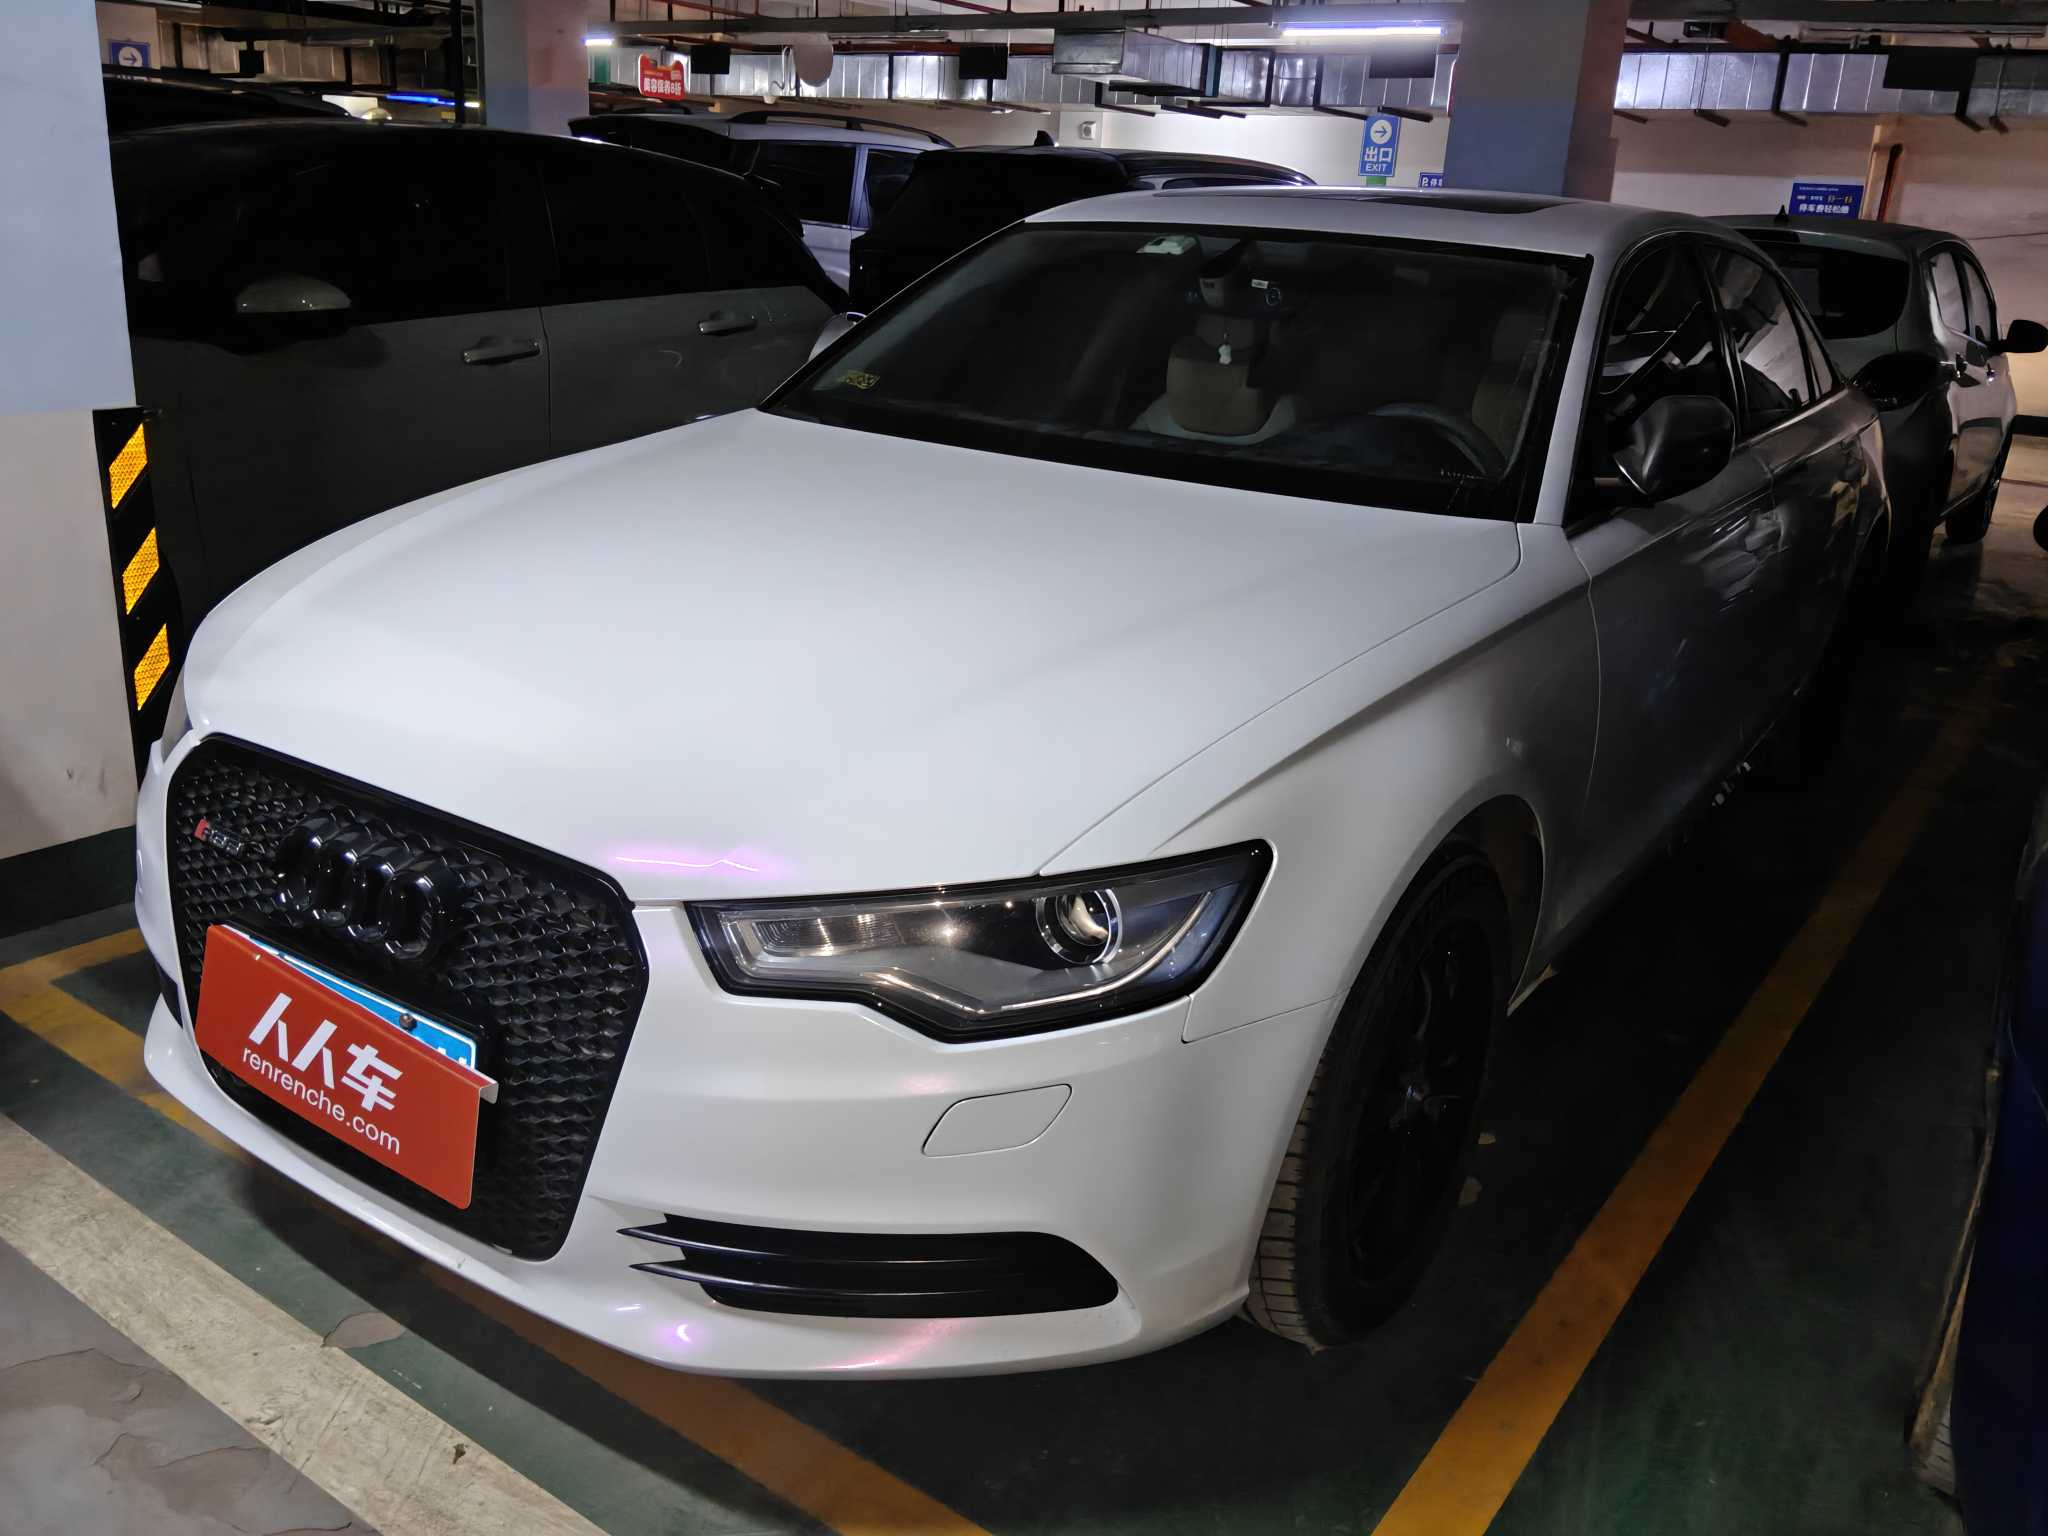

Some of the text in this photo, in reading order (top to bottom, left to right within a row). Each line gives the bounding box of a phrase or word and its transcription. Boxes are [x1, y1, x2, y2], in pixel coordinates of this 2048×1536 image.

[1365, 146, 1392, 162] 出口
[1366, 163, 1387, 172] EXIT
[249, 993, 402, 1112] 人人车
[241, 1048, 400, 1155] renrenche.com
